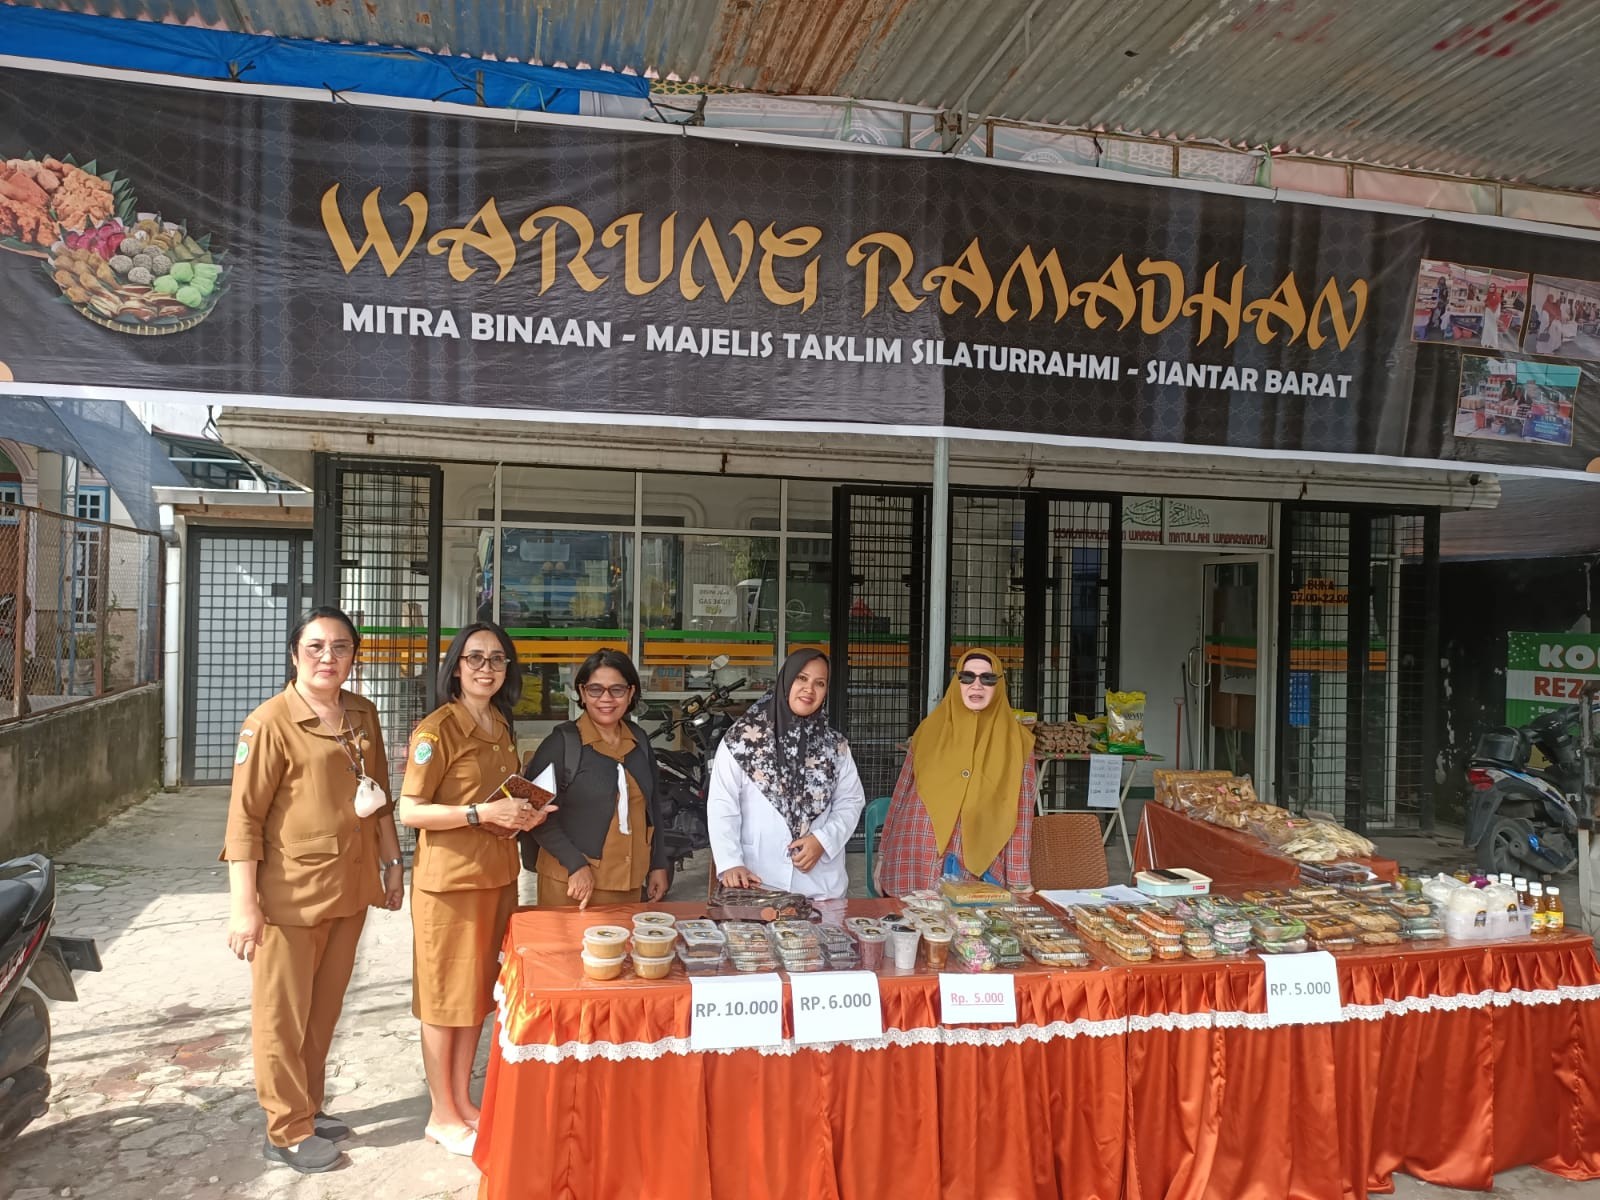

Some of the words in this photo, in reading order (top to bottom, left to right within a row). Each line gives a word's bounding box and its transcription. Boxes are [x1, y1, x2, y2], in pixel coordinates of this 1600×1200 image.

[320, 183, 822, 313] WARUNG
[846, 231, 1368, 351] RAMADHAN
[342, 302, 461, 339] MITRA
[471, 312, 612, 348] BINAAN
[646, 324, 773, 359] MAJELIS
[783, 332, 902, 364] TAKLIM
[911, 338, 1120, 381] SILATURRAHMI
[1146, 359, 1258, 392] SIANTAR
[1264, 370, 1352, 398] BARAT
[1538, 643, 1600, 670] KO
[1534, 675, 1600, 701] REZ
[951, 993, 969, 1005] Rp.
[974, 993, 1004, 1003] 5.000
[1270, 983, 1291, 996] RP.
[1294, 982, 1331, 995] 5.000
[695, 1002, 722, 1018] RP.
[725, 999, 779, 1017] 10.000
[801, 996, 826, 1011] RP.
[829, 992, 873, 1010] 6.000
